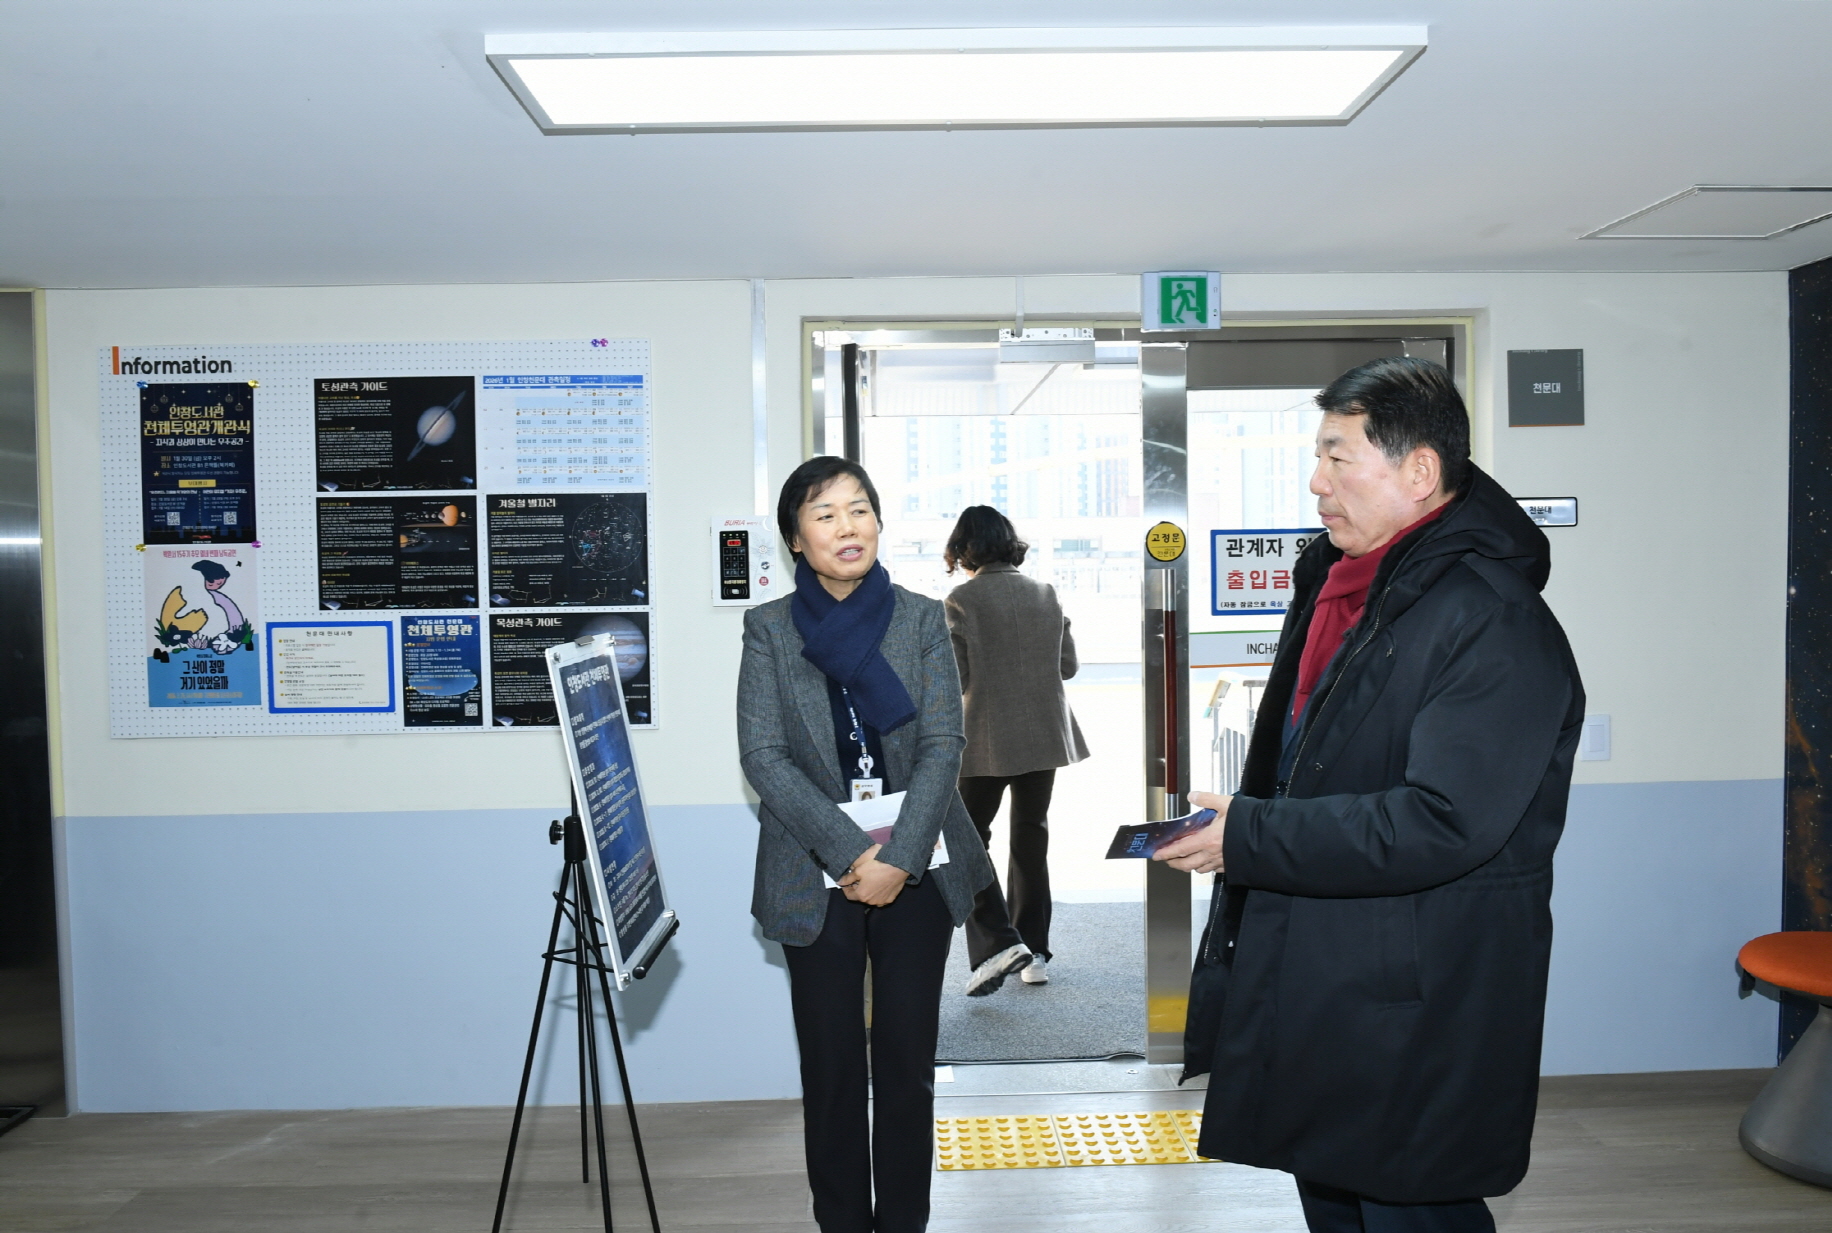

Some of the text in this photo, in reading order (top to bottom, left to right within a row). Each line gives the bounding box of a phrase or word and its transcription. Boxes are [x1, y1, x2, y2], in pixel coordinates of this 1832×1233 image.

[112, 346, 232, 375] Information
[321, 381, 388, 392] 토성관측 가이드
[1533, 382, 1561, 394] 천문대
[169, 405, 225, 420] 인창도서관
[217, 437, 244, 446] 우주공간
[498, 498, 557, 509] 겨울철 별자리
[1151, 533, 1180, 543] 고정문
[1226, 538, 1284, 557] 관계자
[1226, 570, 1292, 589] 출입금
[496, 617, 563, 628] 목성관측 가이드
[407, 624, 473, 636] 천체투영관
[183, 660, 225, 674] 그 산이 정말
[180, 676, 229, 690] 거기 있었을까
